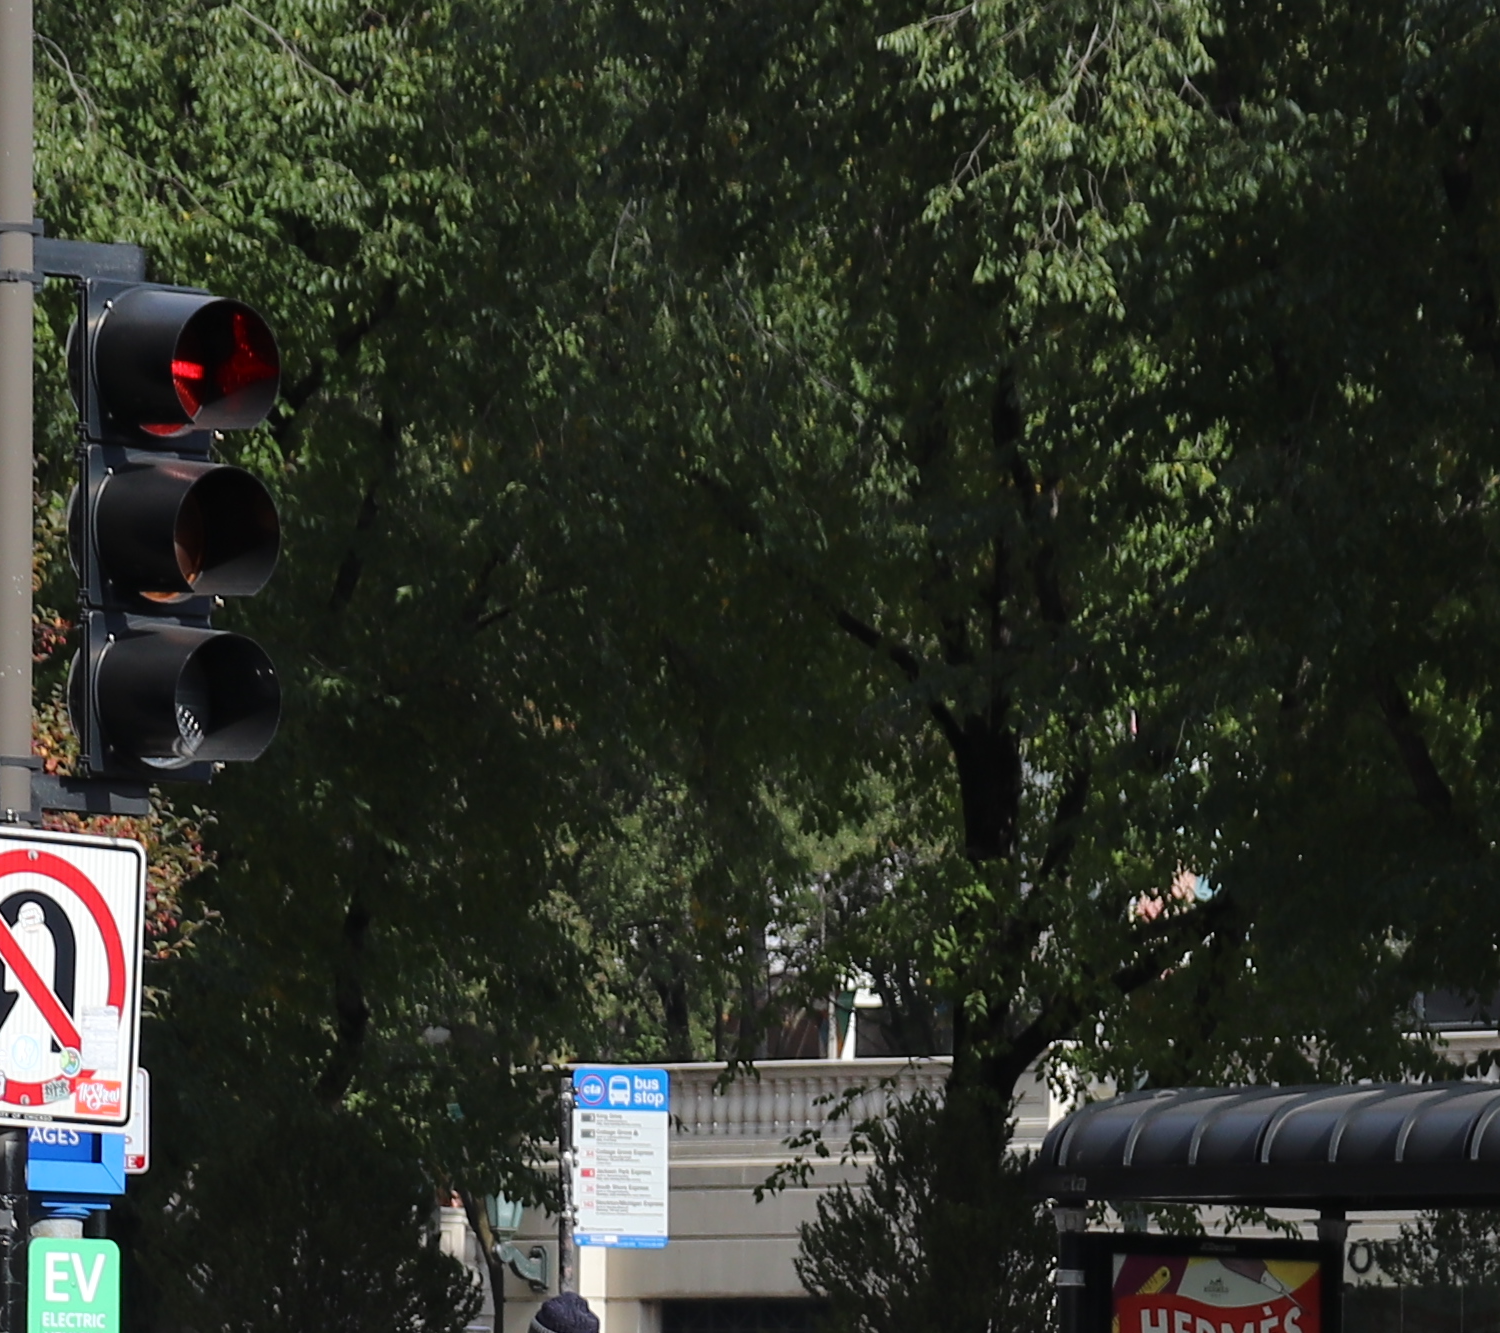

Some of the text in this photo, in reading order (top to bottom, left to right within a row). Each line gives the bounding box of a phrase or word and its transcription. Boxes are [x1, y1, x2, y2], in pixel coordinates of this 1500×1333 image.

[583, 1074, 659, 1095] cta bus
[634, 1090, 665, 1108] stop
[44, 1252, 106, 1303] EV
[41, 1311, 106, 1329] ELECTRIC
